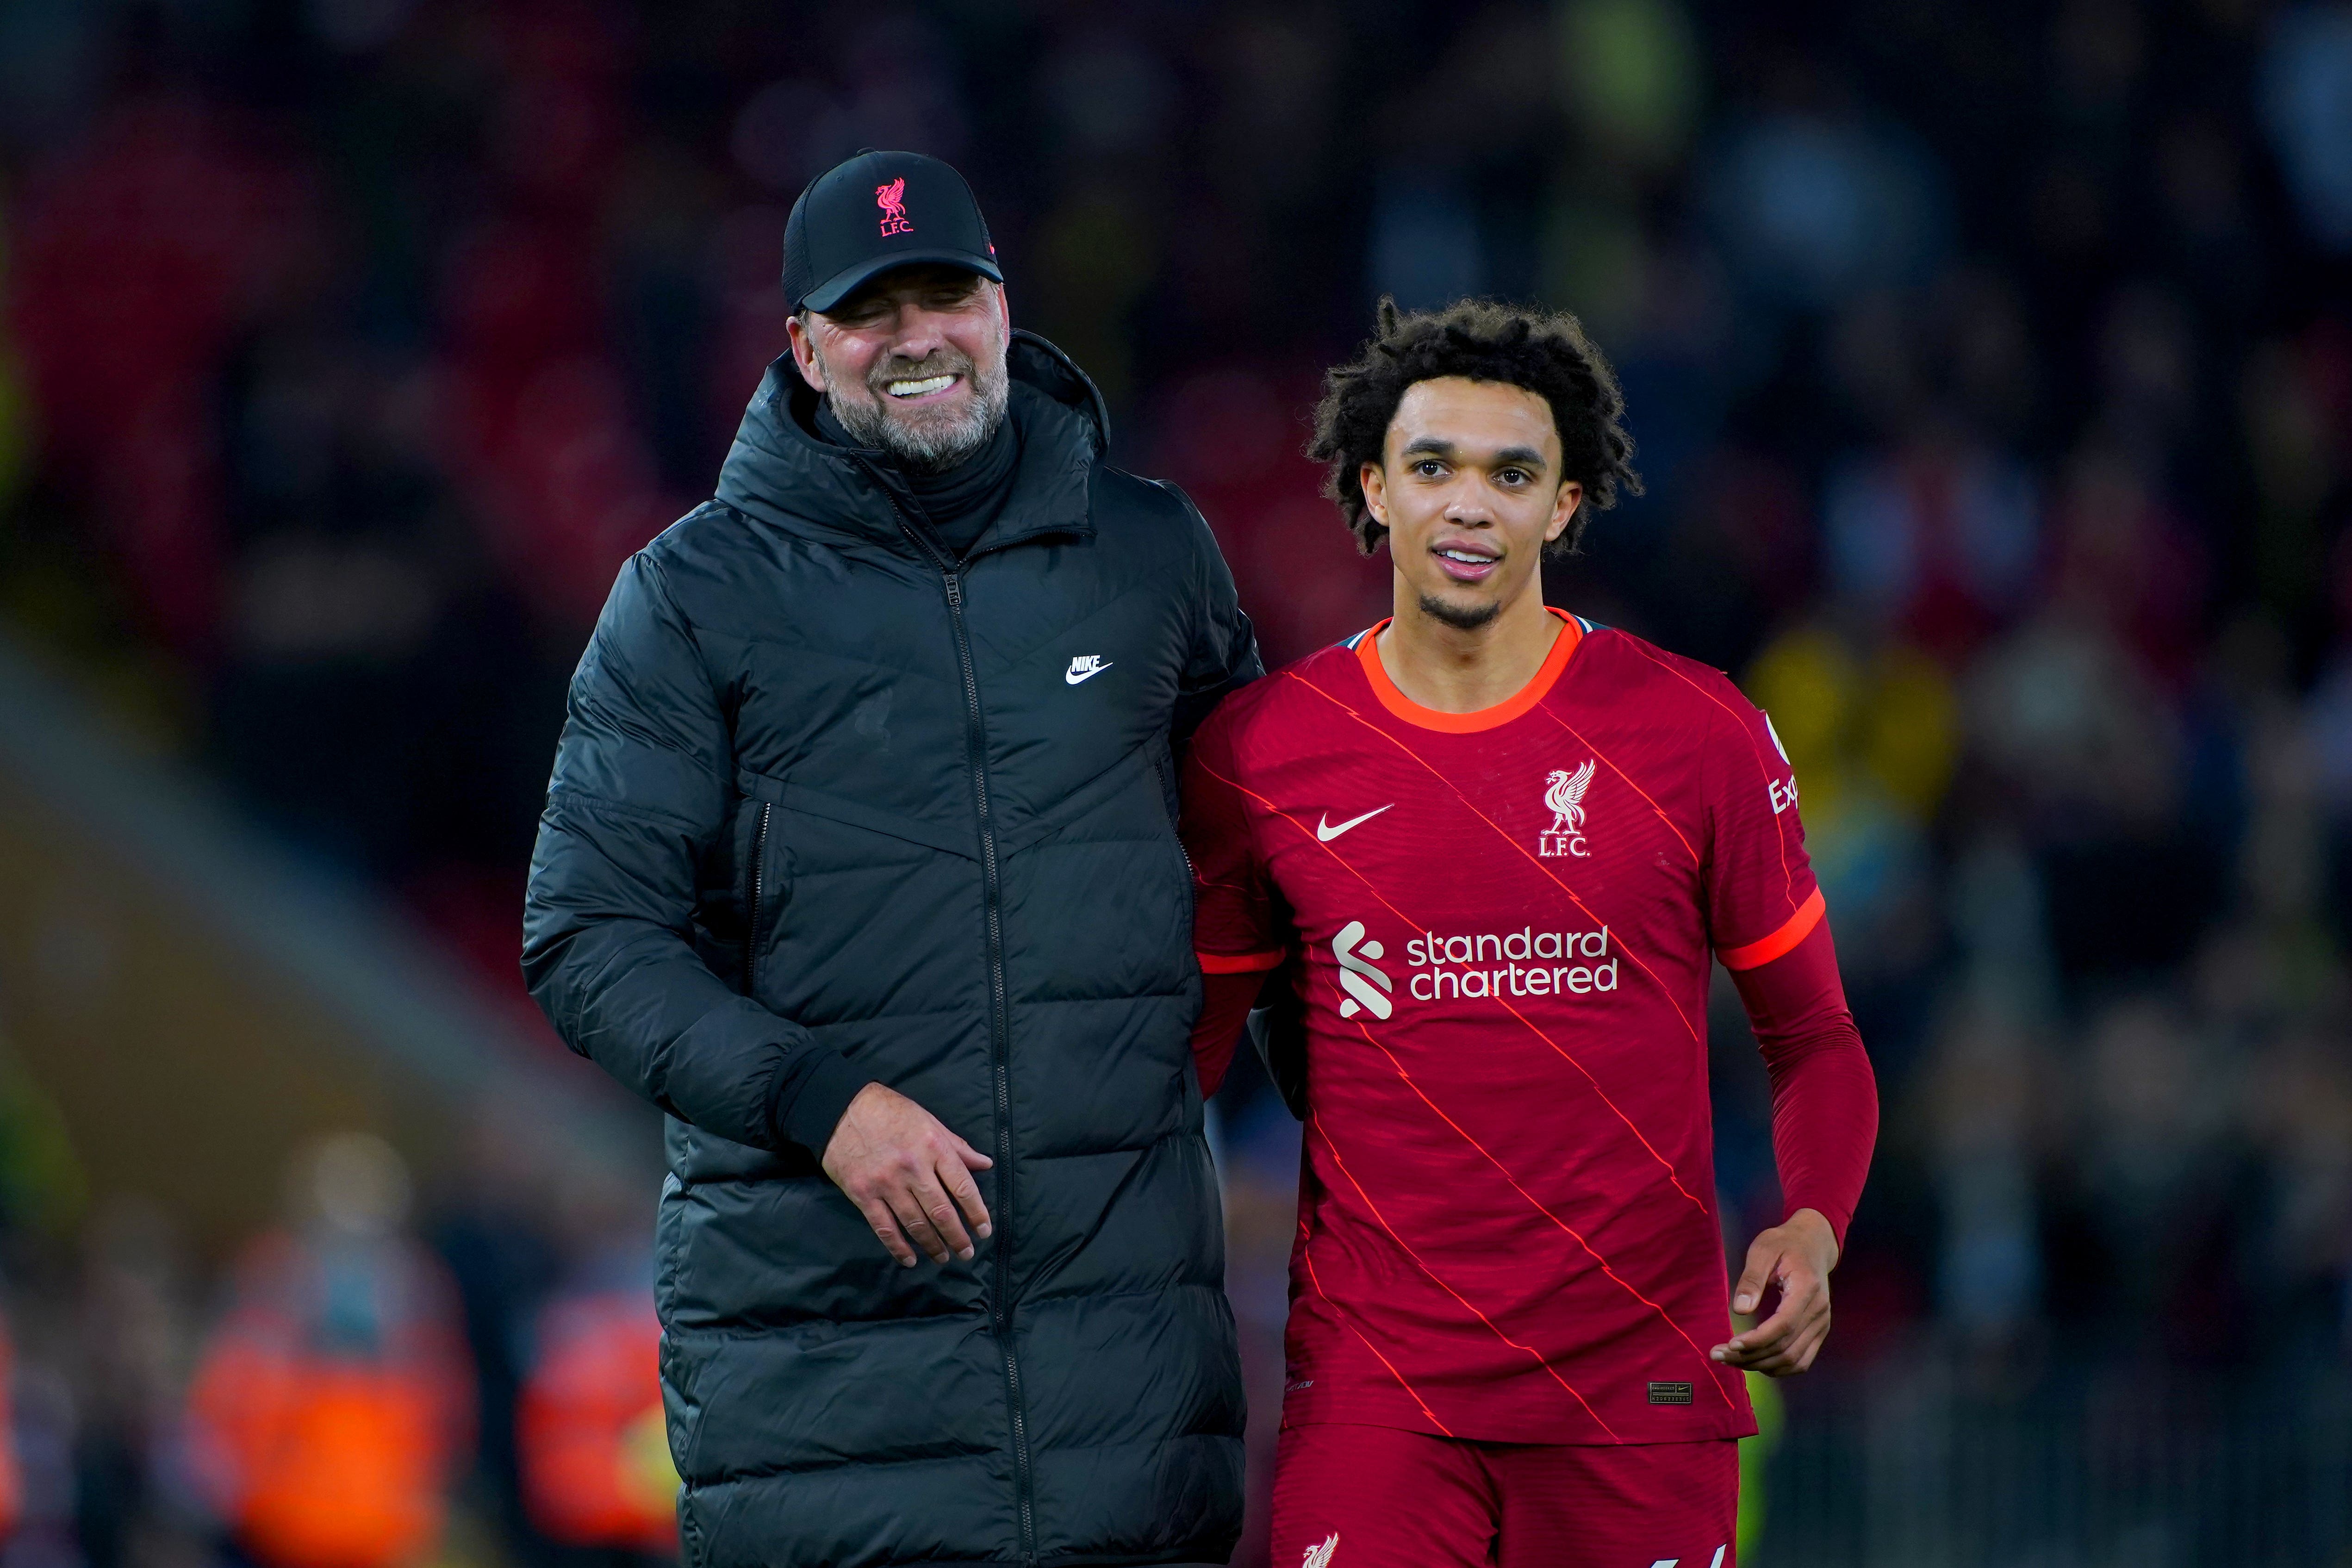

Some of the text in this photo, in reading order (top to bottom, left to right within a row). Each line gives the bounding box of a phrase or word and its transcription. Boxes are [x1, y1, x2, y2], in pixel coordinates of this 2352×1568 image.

[880, 221, 914, 237] L.F.C.
[1071, 655, 1101, 672] NIKE
[1539, 837, 1591, 856] L.F.C.
[1407, 925, 1608, 966] standard
[1410, 958, 1618, 1000] chartered
